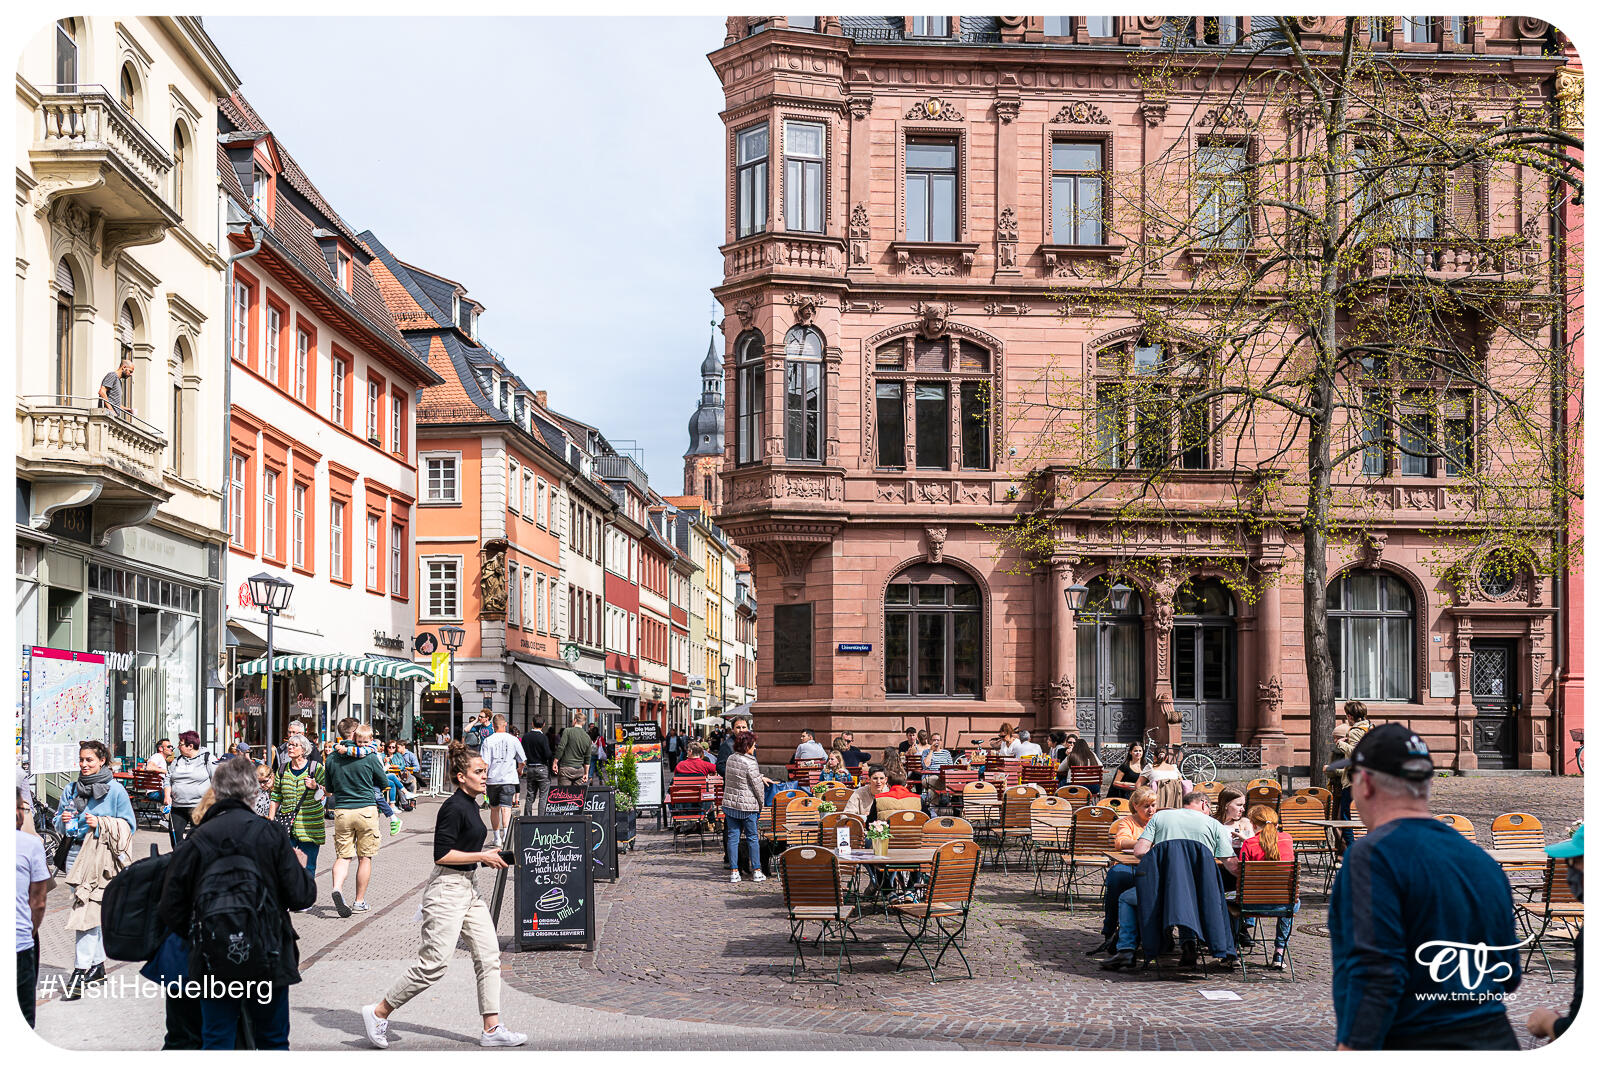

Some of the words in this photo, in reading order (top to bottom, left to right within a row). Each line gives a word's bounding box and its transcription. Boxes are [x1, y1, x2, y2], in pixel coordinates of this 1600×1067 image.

[249, 706, 262, 716] PIZZA
[301, 708, 313, 718] PIZZA
[531, 827, 574, 851] Angebot
[525, 851, 549, 866] Kaffee
[551, 851, 555, 862] &
[556, 850, 582, 863] Kuchen
